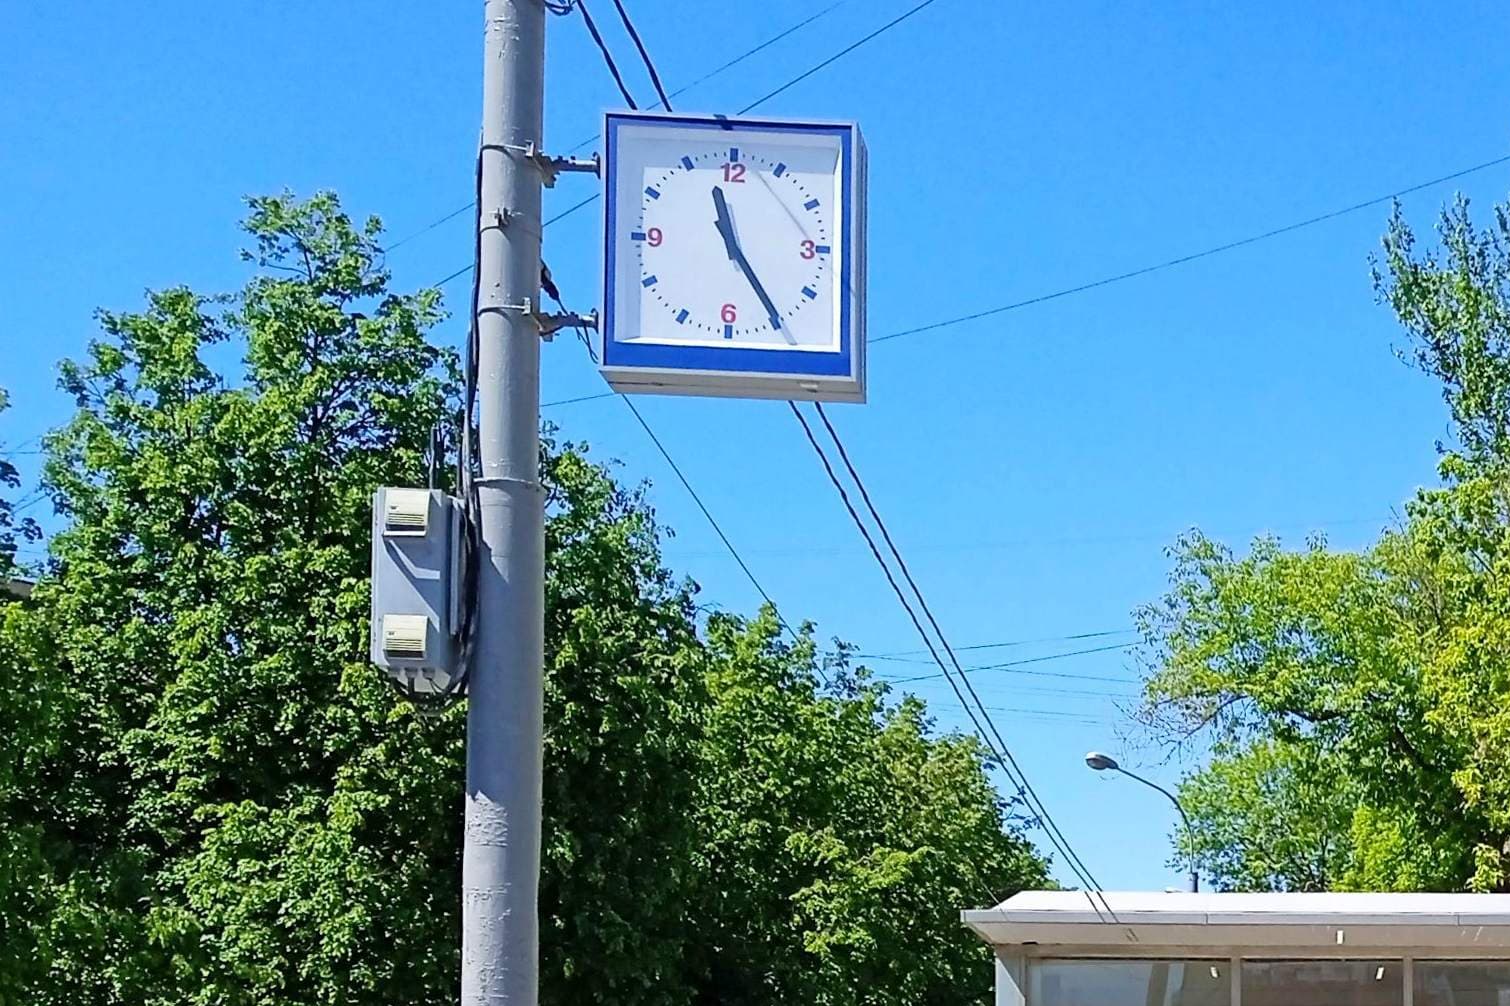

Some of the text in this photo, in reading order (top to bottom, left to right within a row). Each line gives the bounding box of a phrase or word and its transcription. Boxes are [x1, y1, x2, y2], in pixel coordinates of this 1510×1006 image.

[720, 163, 746, 184] 12
[647, 227, 664, 247] 9
[800, 240, 816, 260] 3
[720, 304, 737, 323] 6
